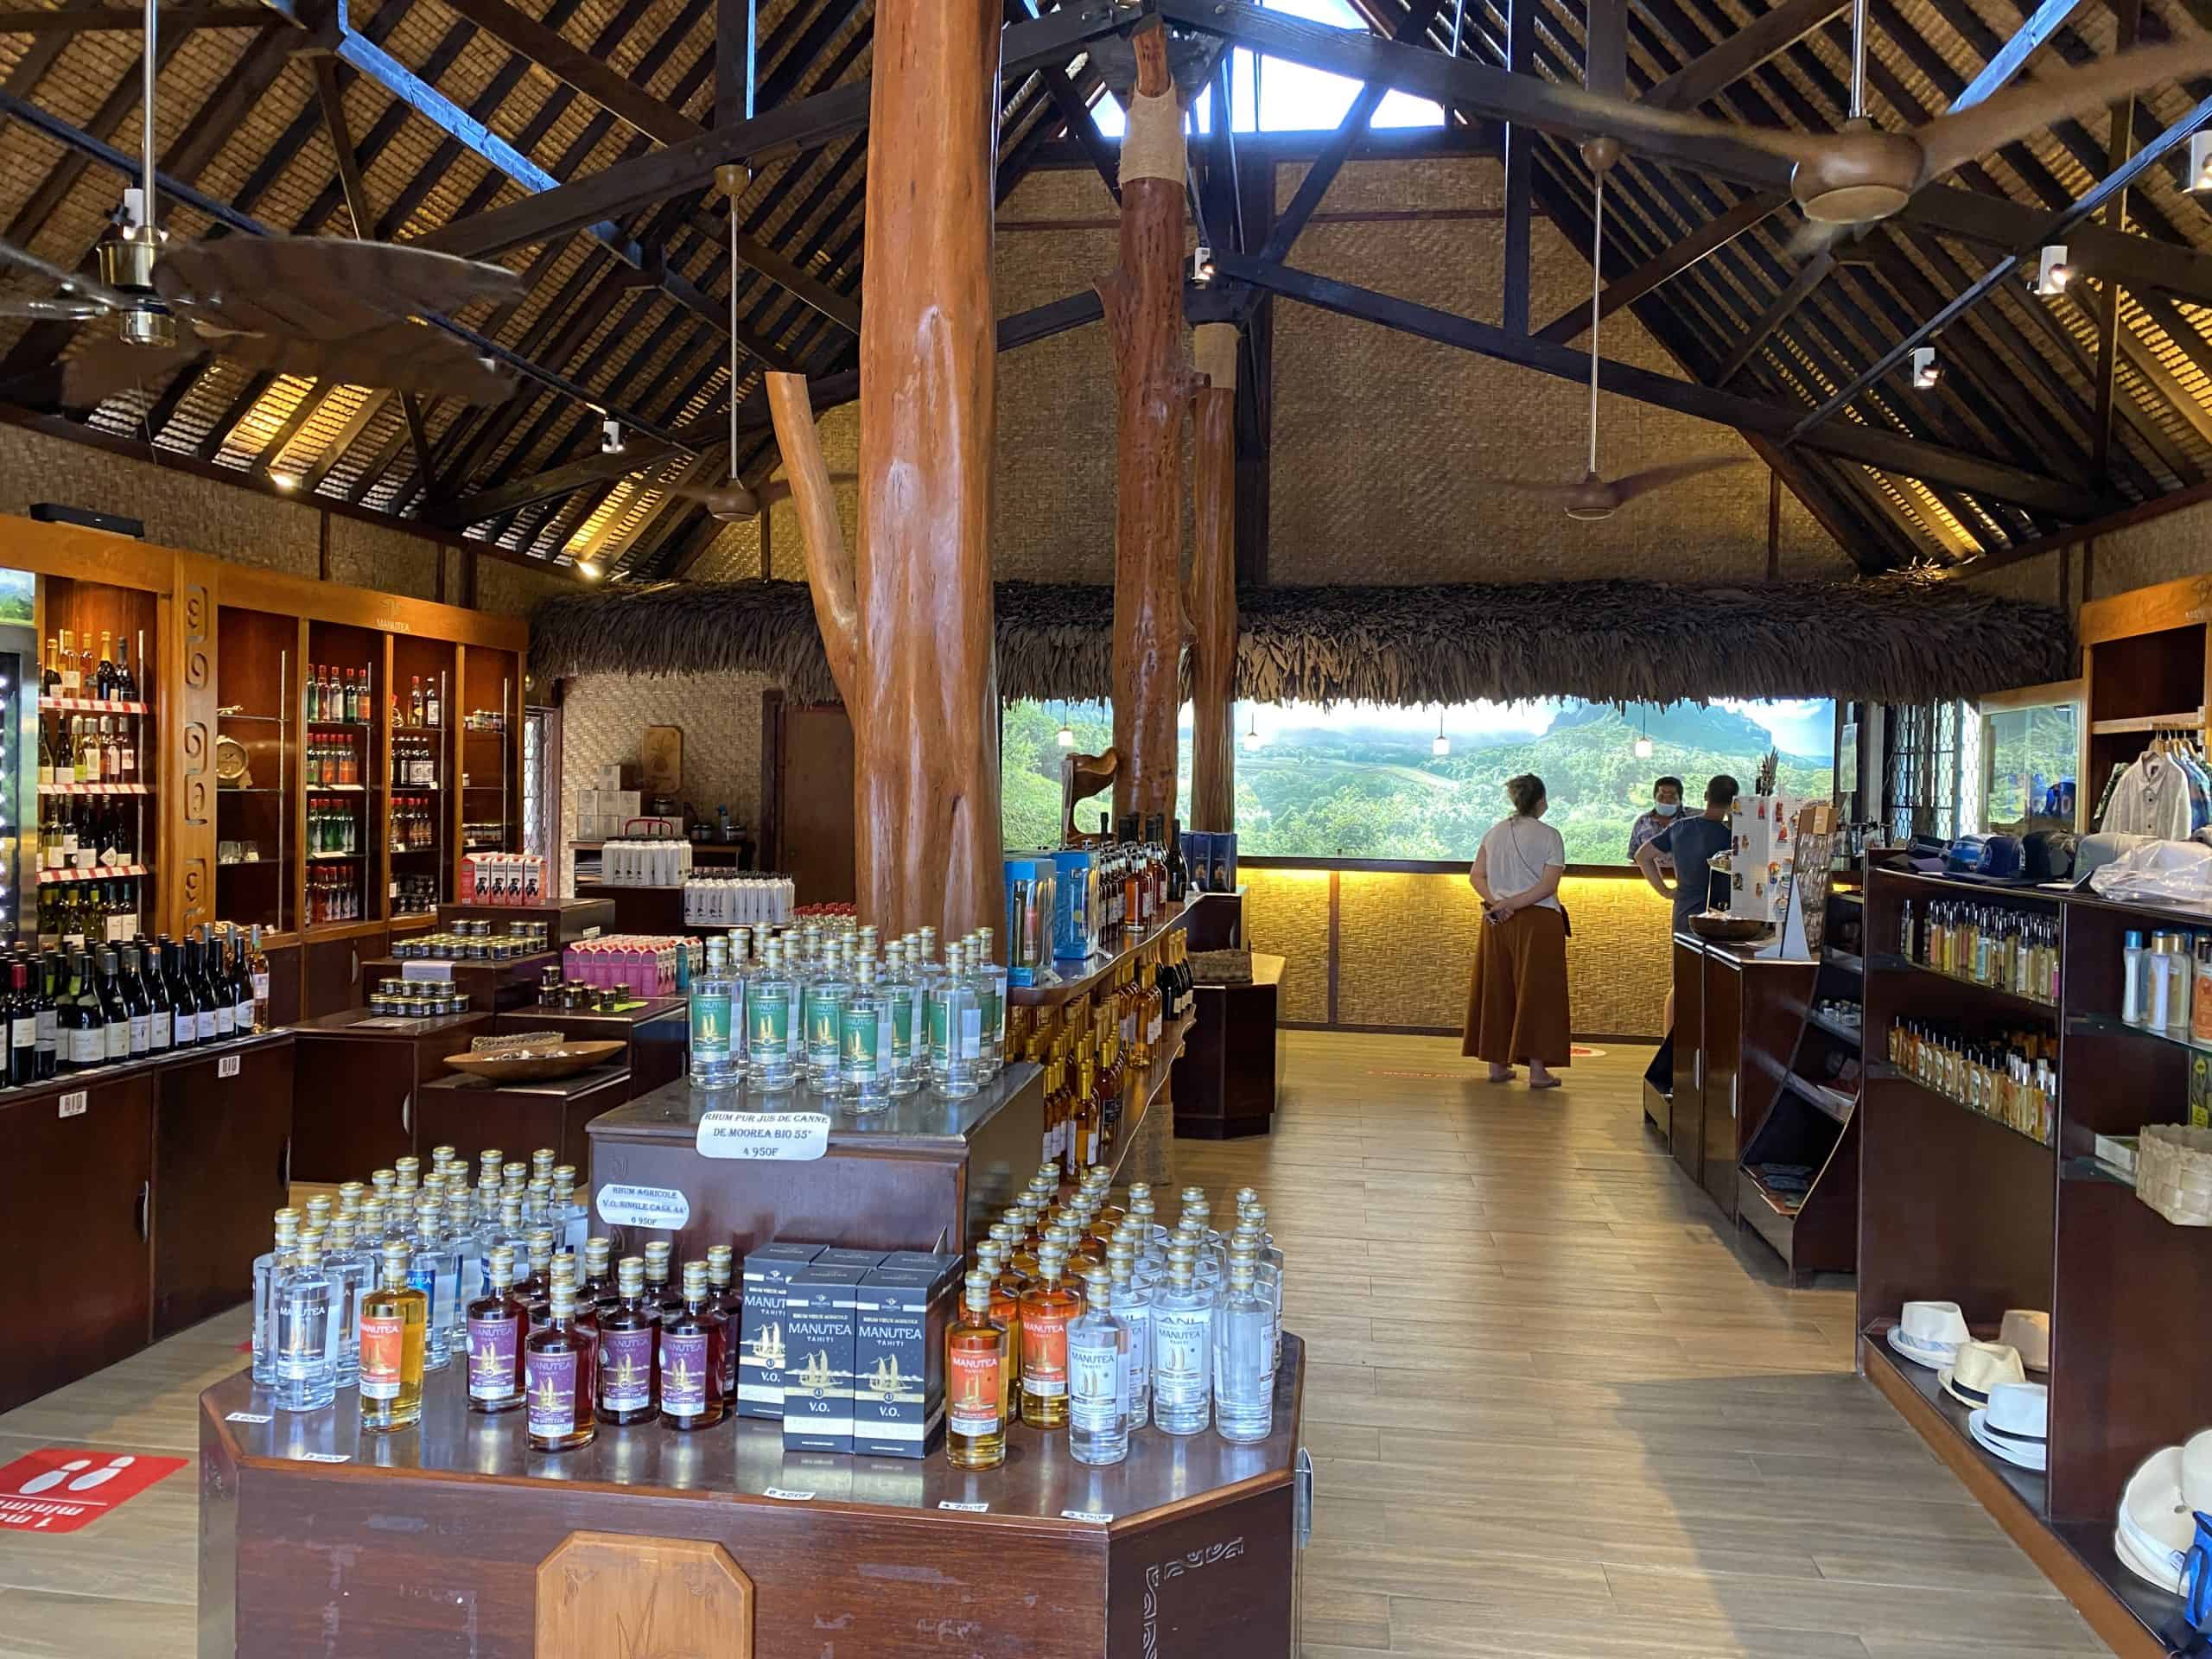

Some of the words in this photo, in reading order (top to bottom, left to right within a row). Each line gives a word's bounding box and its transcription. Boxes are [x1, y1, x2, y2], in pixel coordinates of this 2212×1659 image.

[222, 1057, 238, 1073] BIO
[64, 1093, 83, 1112] BIO
[734, 1114, 756, 1122] PUR
[793, 1115, 829, 1124] CANNE
[713, 1128, 727, 1137] DE
[728, 1128, 772, 1139] MOOREA
[773, 1129, 791, 1139] BIO
[743, 1147, 749, 1156] 4
[752, 1147, 779, 1157] 950F
[744, 1296, 785, 1309] MANUT
[788, 1323, 852, 1336] MANUTEA
[859, 1326, 922, 1340] MANUTEA
[1023, 1321, 1065, 1333] MANUTEA
[1158, 1328, 1201, 1340] MANUTEA
[876, 1339, 905, 1348] TAHITI
[953, 1357, 998, 1369] MANUTEA
[1071, 1351, 1115, 1363] MANUTEA
[760, 1371, 781, 1382] V.O.
[809, 1402, 830, 1413] V.O.
[879, 1406, 900, 1418] V.O.
[0, 1500, 86, 1516] minim
